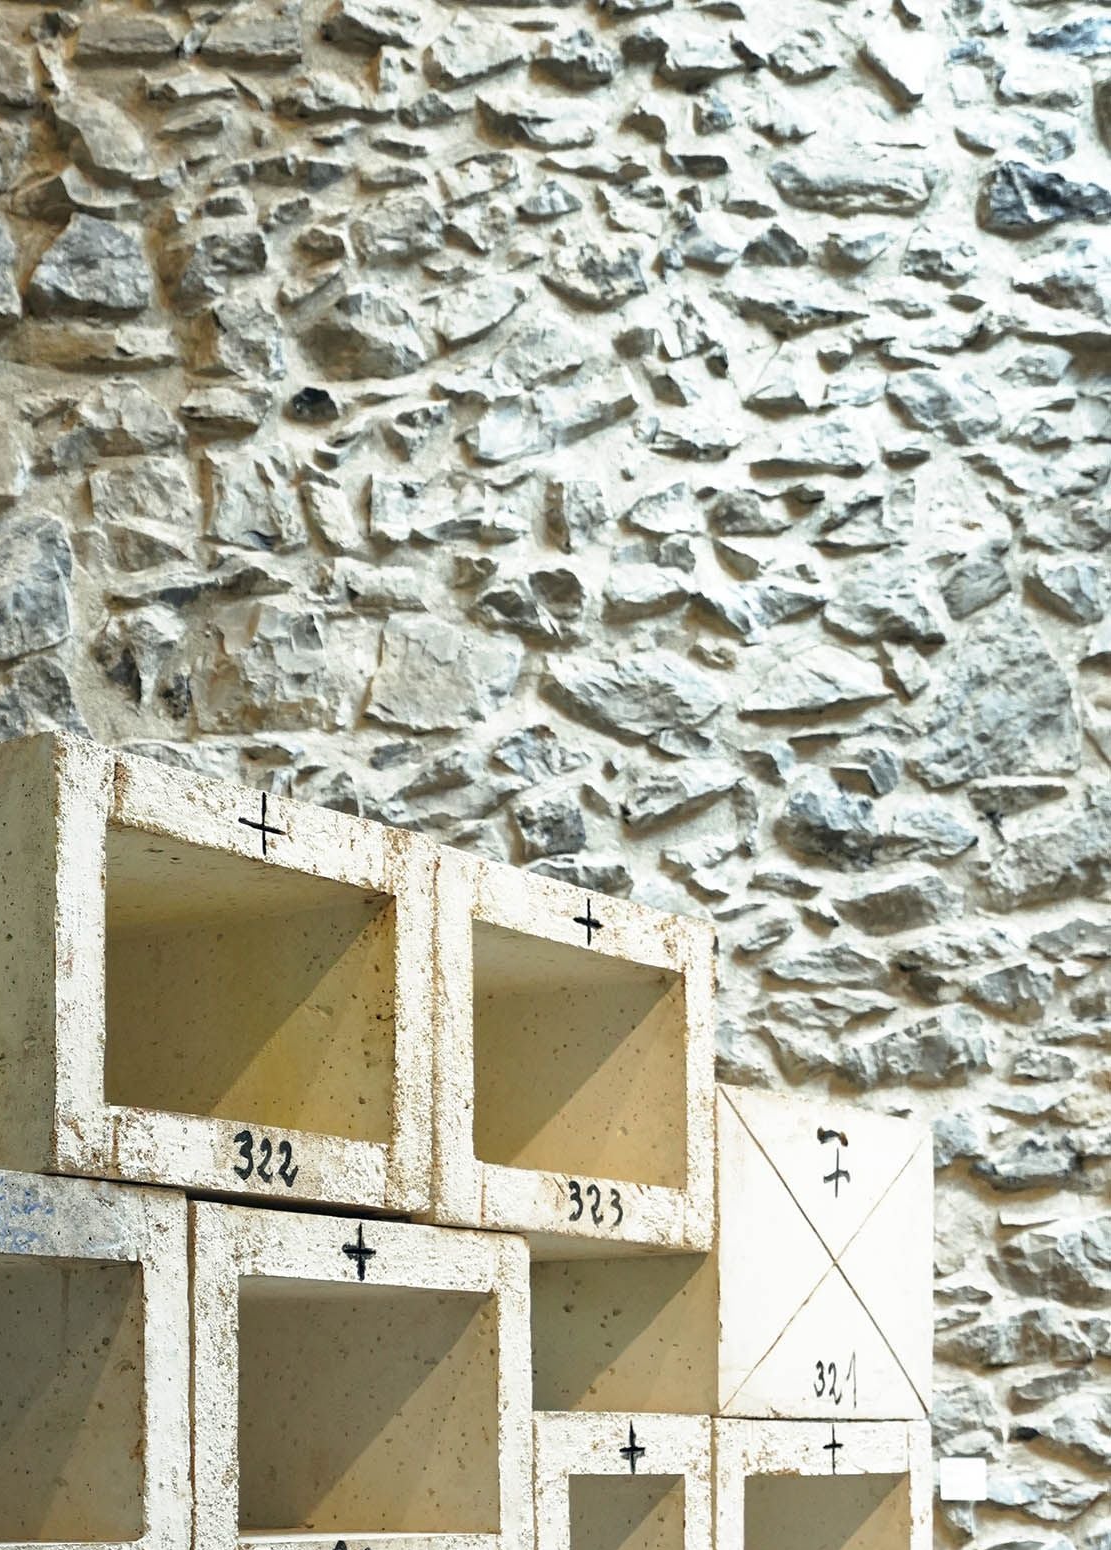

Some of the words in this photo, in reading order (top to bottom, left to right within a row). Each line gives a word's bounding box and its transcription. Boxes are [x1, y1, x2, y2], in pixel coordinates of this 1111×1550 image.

[233, 1129, 300, 1188] 322
[567, 1179, 625, 1227] 323
[813, 1350, 857, 1409] 321
